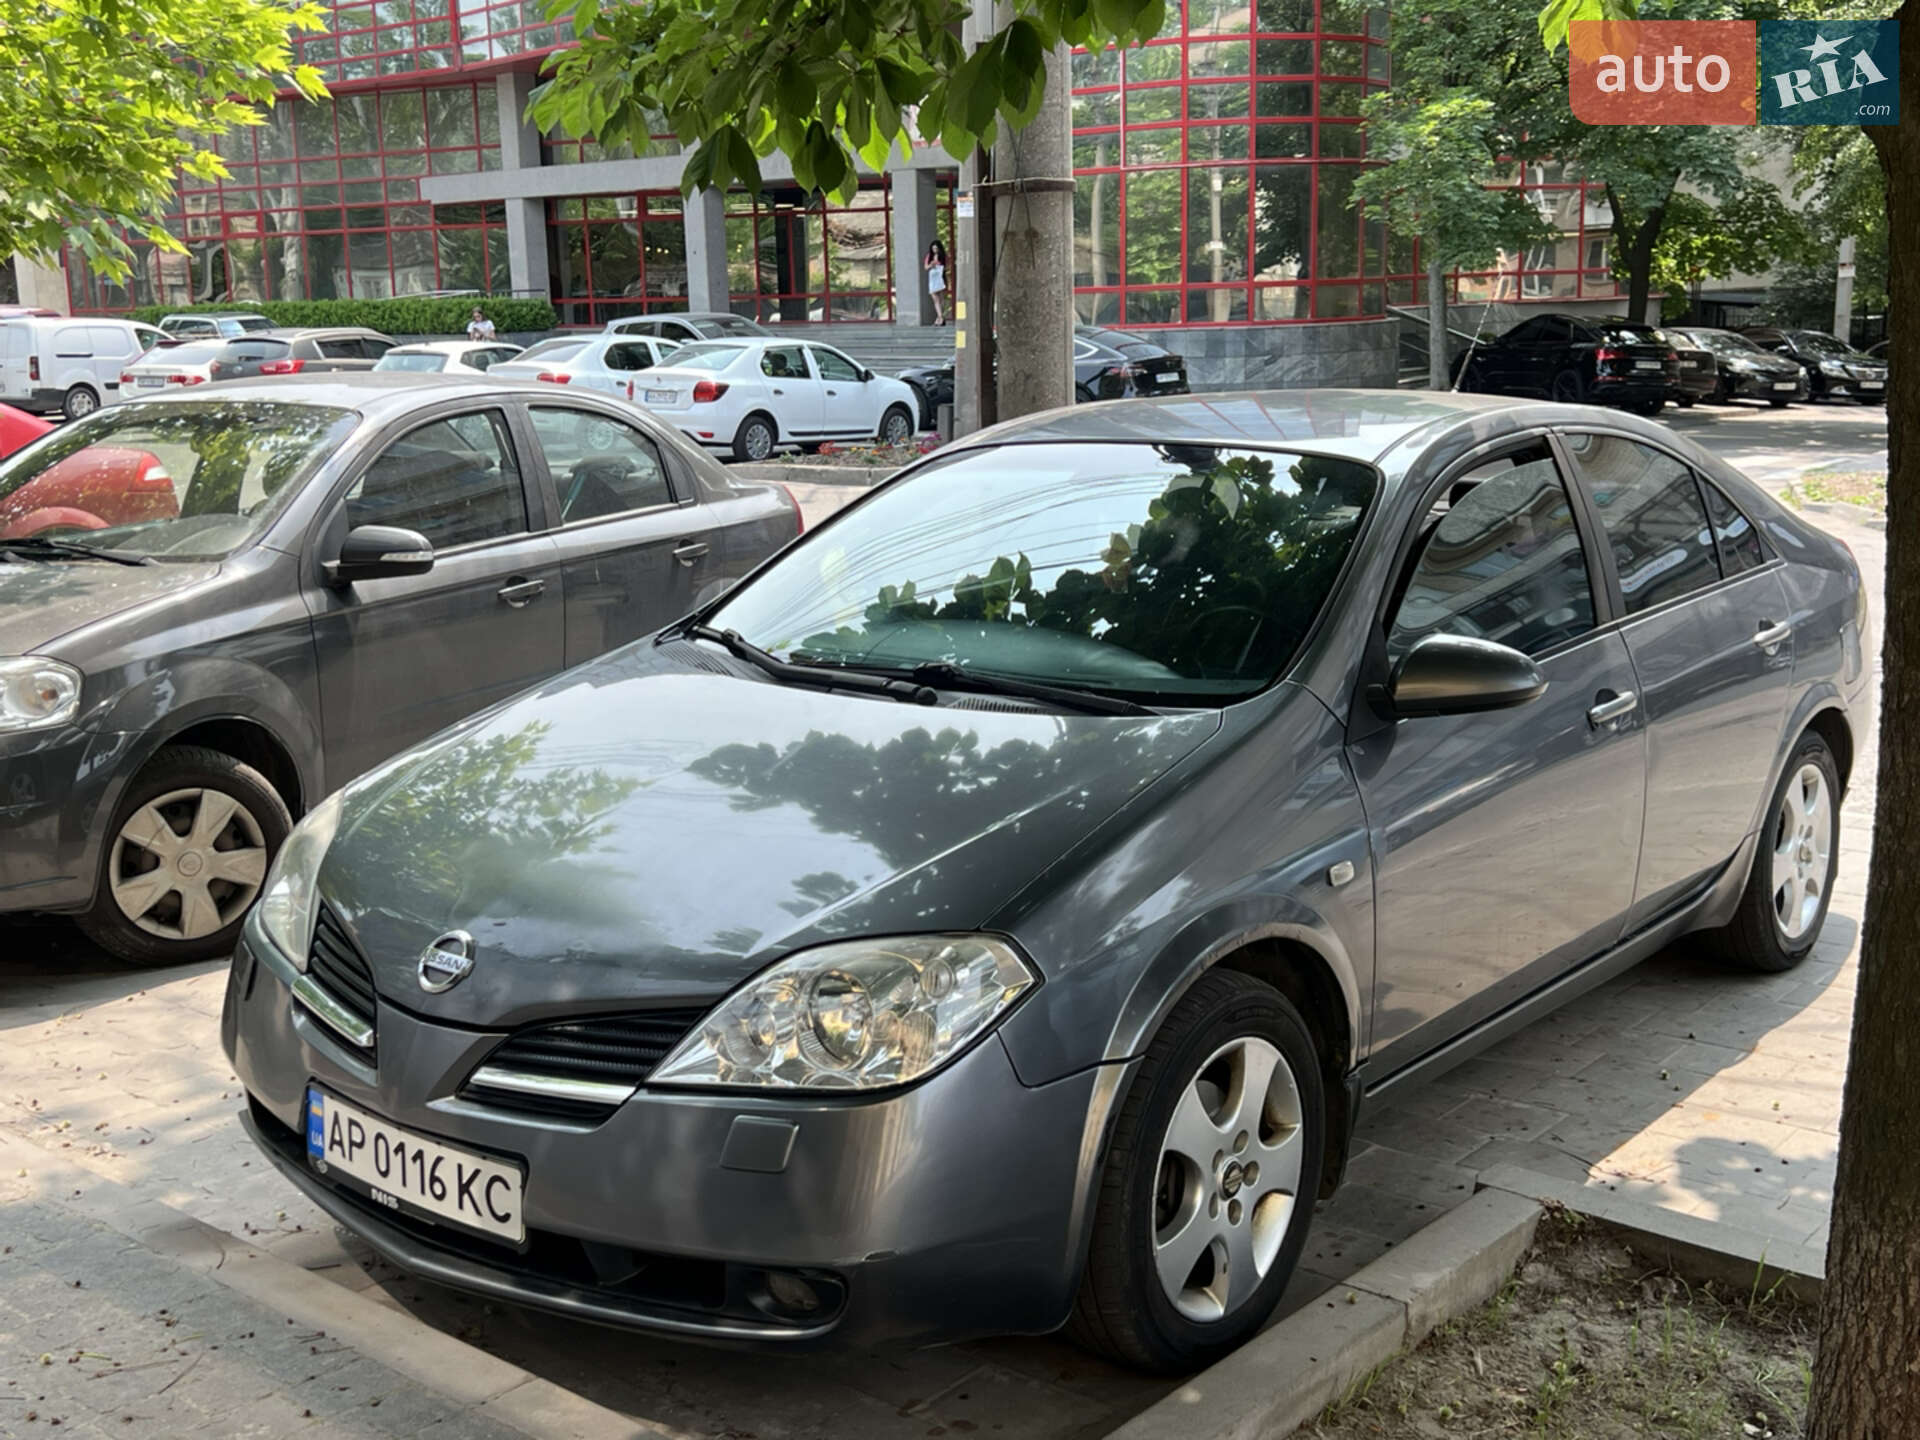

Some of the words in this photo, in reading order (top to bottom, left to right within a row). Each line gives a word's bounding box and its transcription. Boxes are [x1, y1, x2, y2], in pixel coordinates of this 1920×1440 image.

[312, 1131, 323, 1148] UA
[328, 1110, 365, 1161] AP
[374, 1131, 446, 1201] 0116
[456, 1163, 512, 1223] KC
